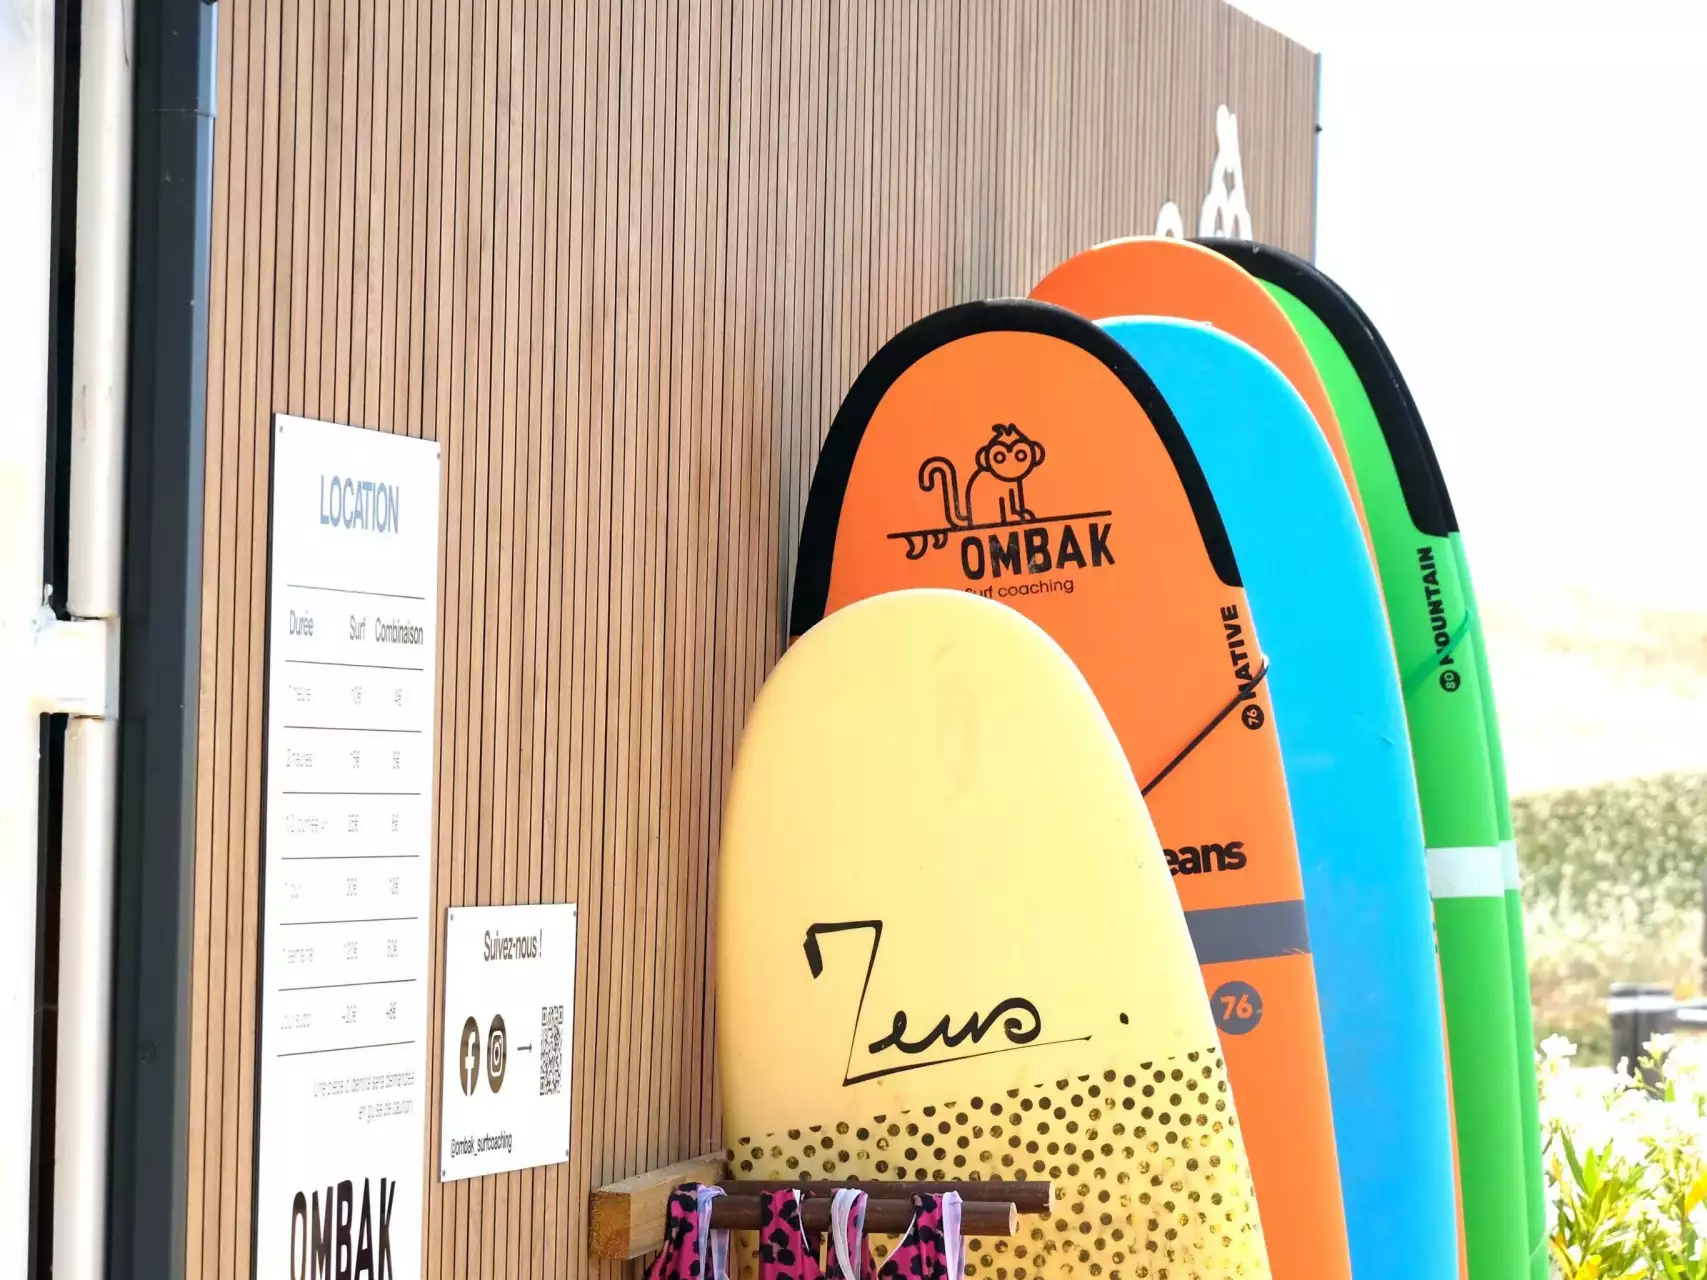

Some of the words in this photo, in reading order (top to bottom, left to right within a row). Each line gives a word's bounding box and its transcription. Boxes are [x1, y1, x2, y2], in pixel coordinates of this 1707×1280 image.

[320, 475, 399, 534] LOCATION
[961, 523, 1115, 580] OMBAK
[998, 579, 1074, 598] coaching
[289, 609, 314, 637] Durée
[349, 614, 366, 641] Surf
[375, 616, 424, 645] Combinaison
[1220, 994, 1253, 1020] 76
